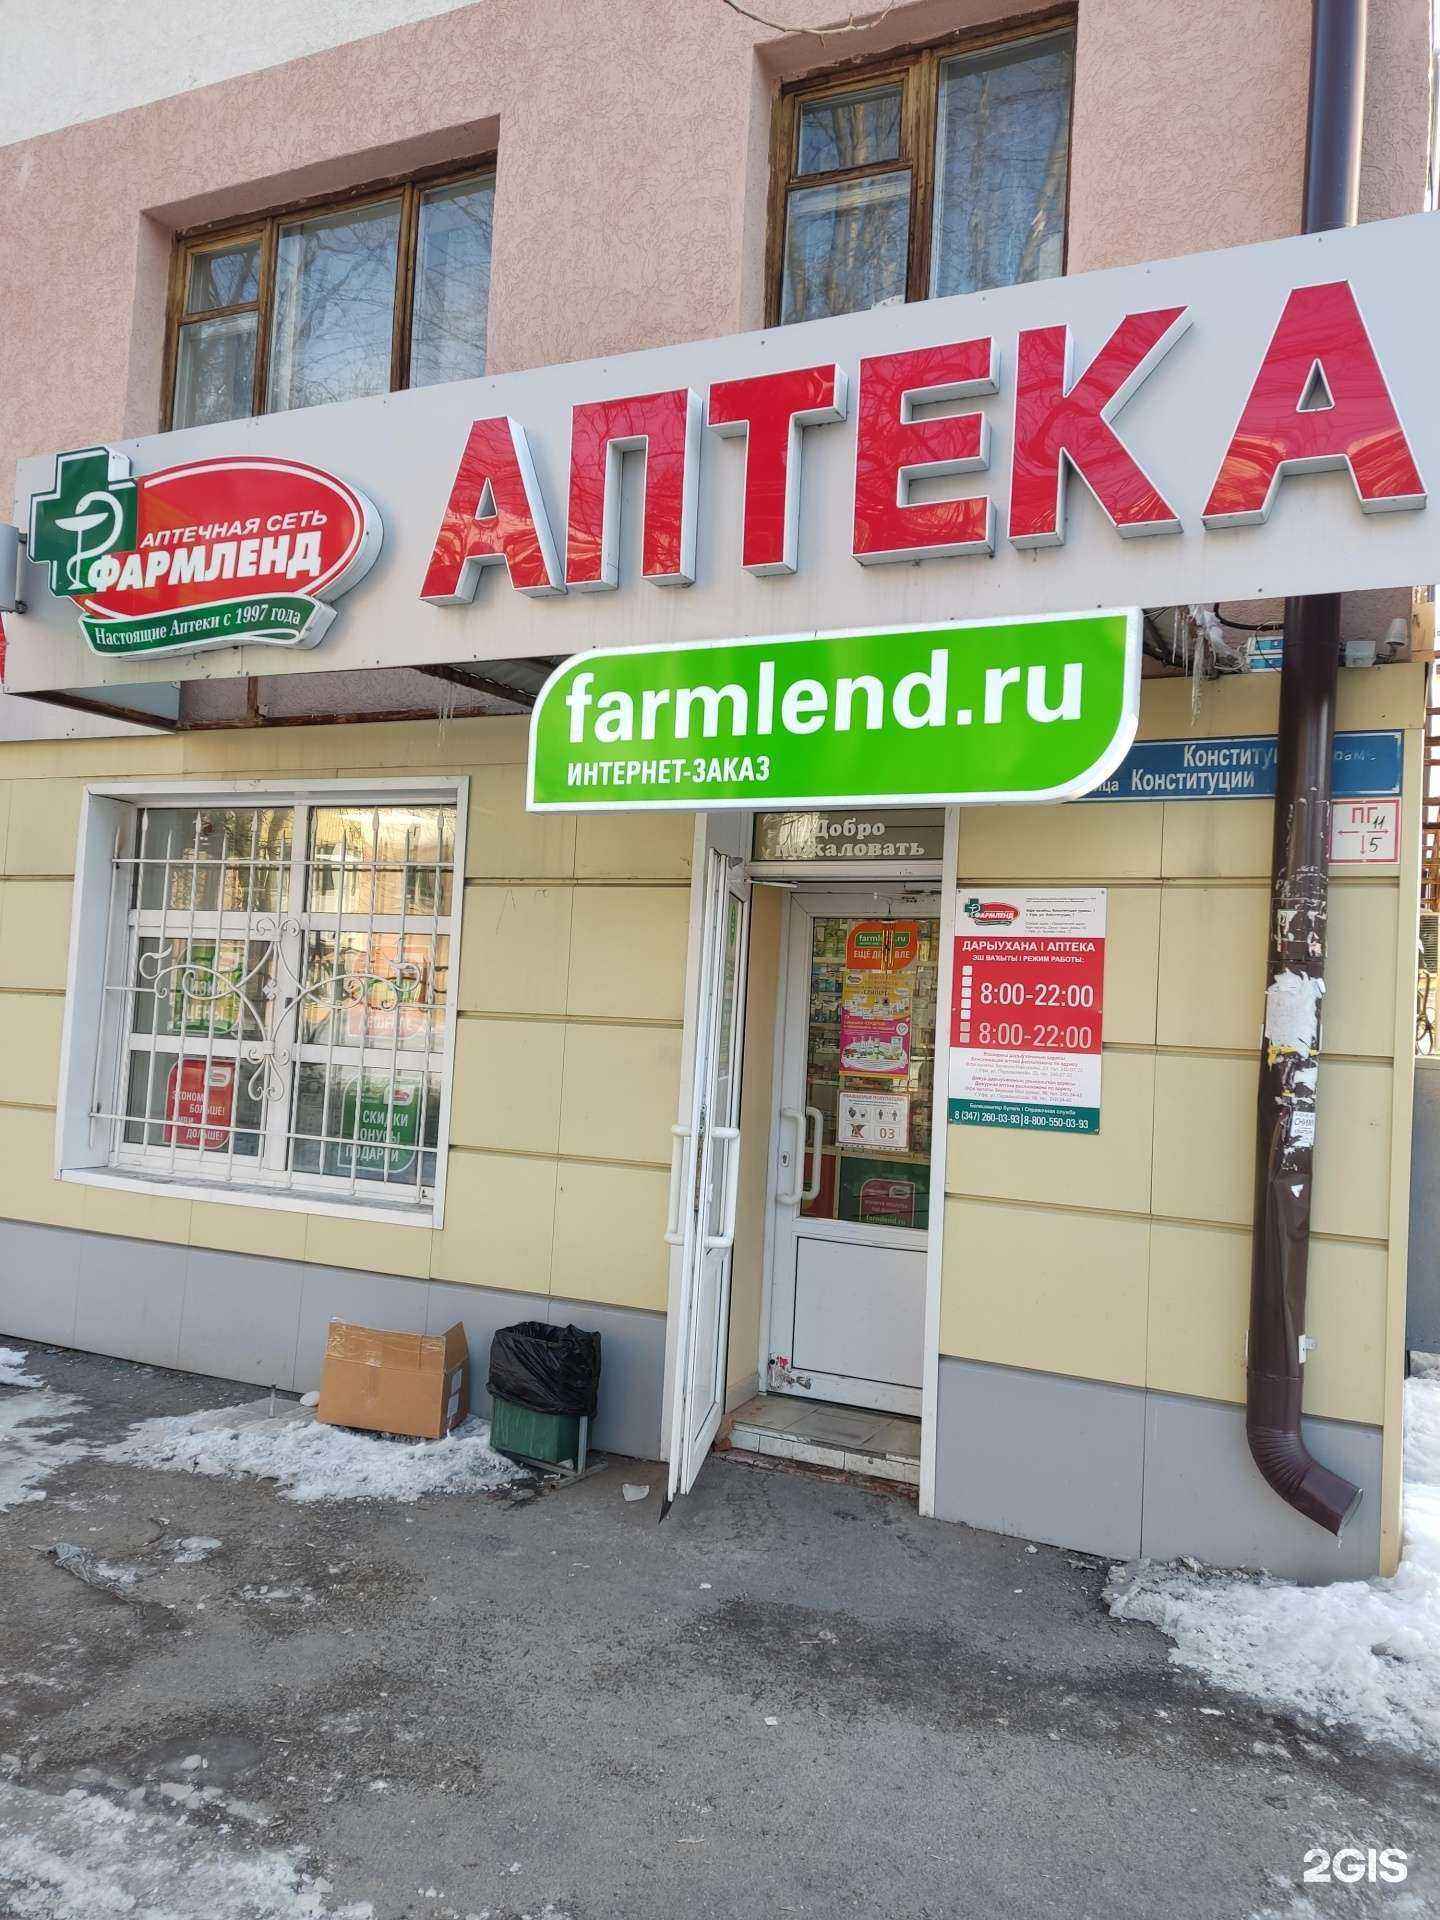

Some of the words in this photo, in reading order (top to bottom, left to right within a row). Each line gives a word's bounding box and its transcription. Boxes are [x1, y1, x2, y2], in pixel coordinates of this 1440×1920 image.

[420, 281, 1427, 606] АПТЕКА
[140, 516, 261, 549] АПТЕЧНАЯ
[265, 508, 328, 532] СЕТЬ
[88, 530, 322, 593] ФАРМЛЕНД
[95, 622, 167, 646] Настоящие
[169, 614, 219, 637] Аптеки
[223, 612, 231, 626] с
[235, 604, 268, 625] 1997
[271, 606, 301, 626] года
[565, 648, 1083, 744] farmlend.ru
[567, 754, 771, 787] ИНТЕРНЕТ-ЗАКАЗ
[1131, 768, 1254, 795] Конституции
[1351, 806, 1378, 824] ПГ
[814, 817, 886, 840] Добро
[1369, 837, 1383, 853] 5
[962, 940, 1038, 952] ДАРЫУХАНА
[1047, 941, 1096, 952] АПТЕКА
[980, 982, 1094, 1008] 8:00-22:00
[979, 1022, 1092, 1048] 8:00-22:00
[954, 1110, 960, 1120] 8
[961, 1110, 980, 1121] (347)
[879, 1127, 896, 1140] 03
